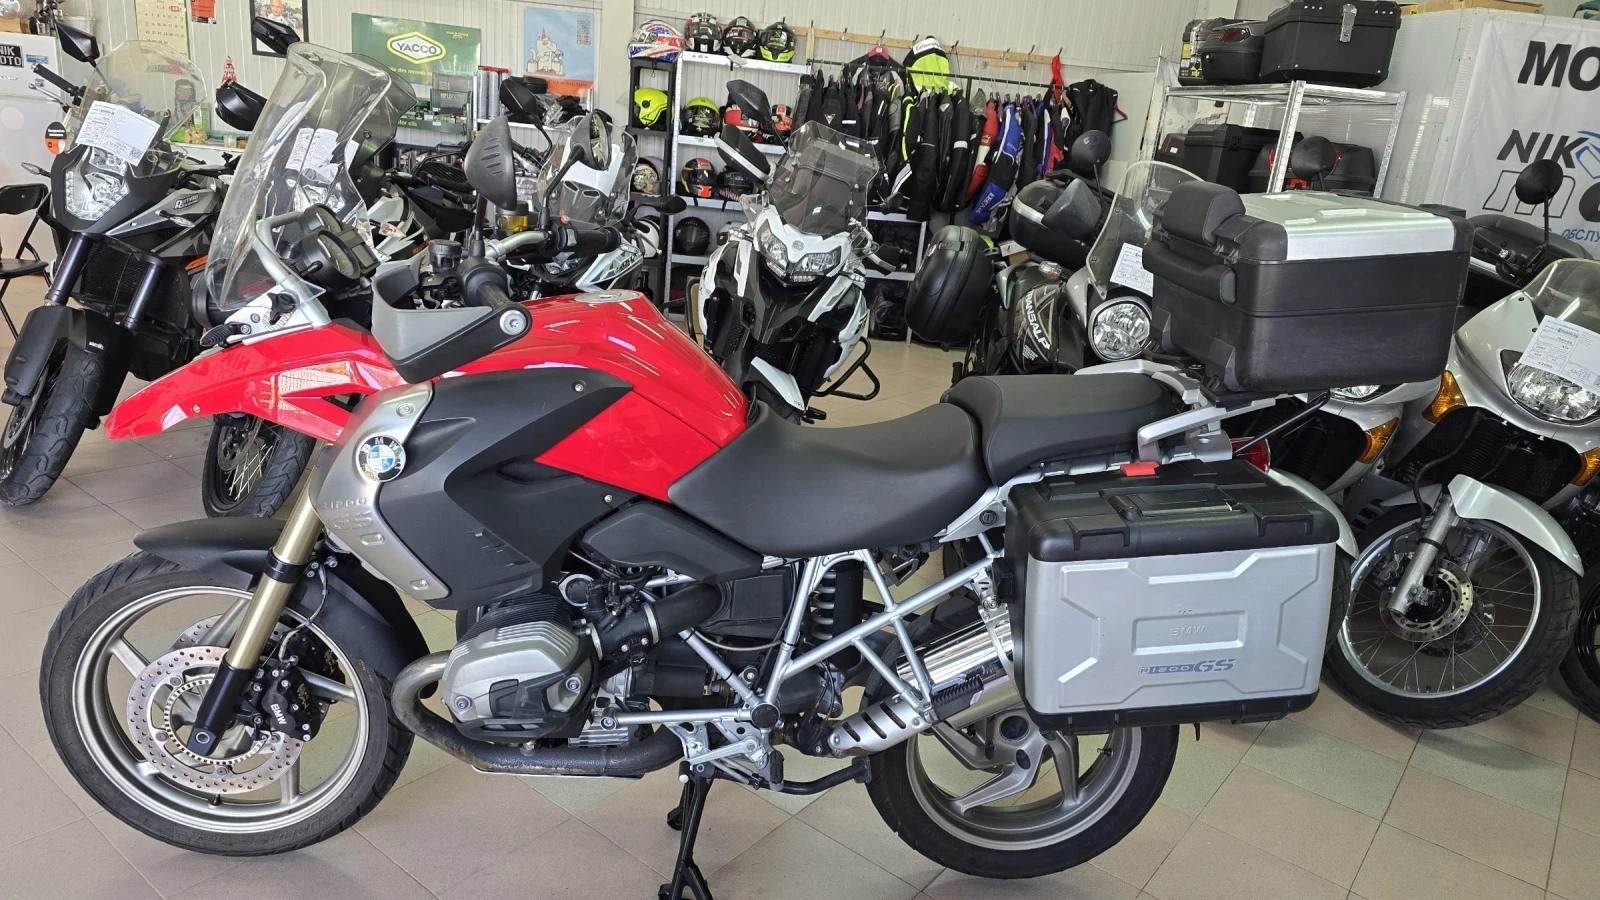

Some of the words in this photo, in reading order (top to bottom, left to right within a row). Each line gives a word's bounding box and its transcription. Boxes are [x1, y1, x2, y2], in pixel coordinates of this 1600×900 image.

[0, 45, 15, 56] NIK
[396, 42, 437, 55] YACCO
[1517, 40, 1600, 91] MO
[1496, 128, 1590, 169] NIK
[1025, 289, 1051, 350] TRANSALP
[1169, 625, 1205, 637] BMW
[270, 703, 288, 725] BMW
